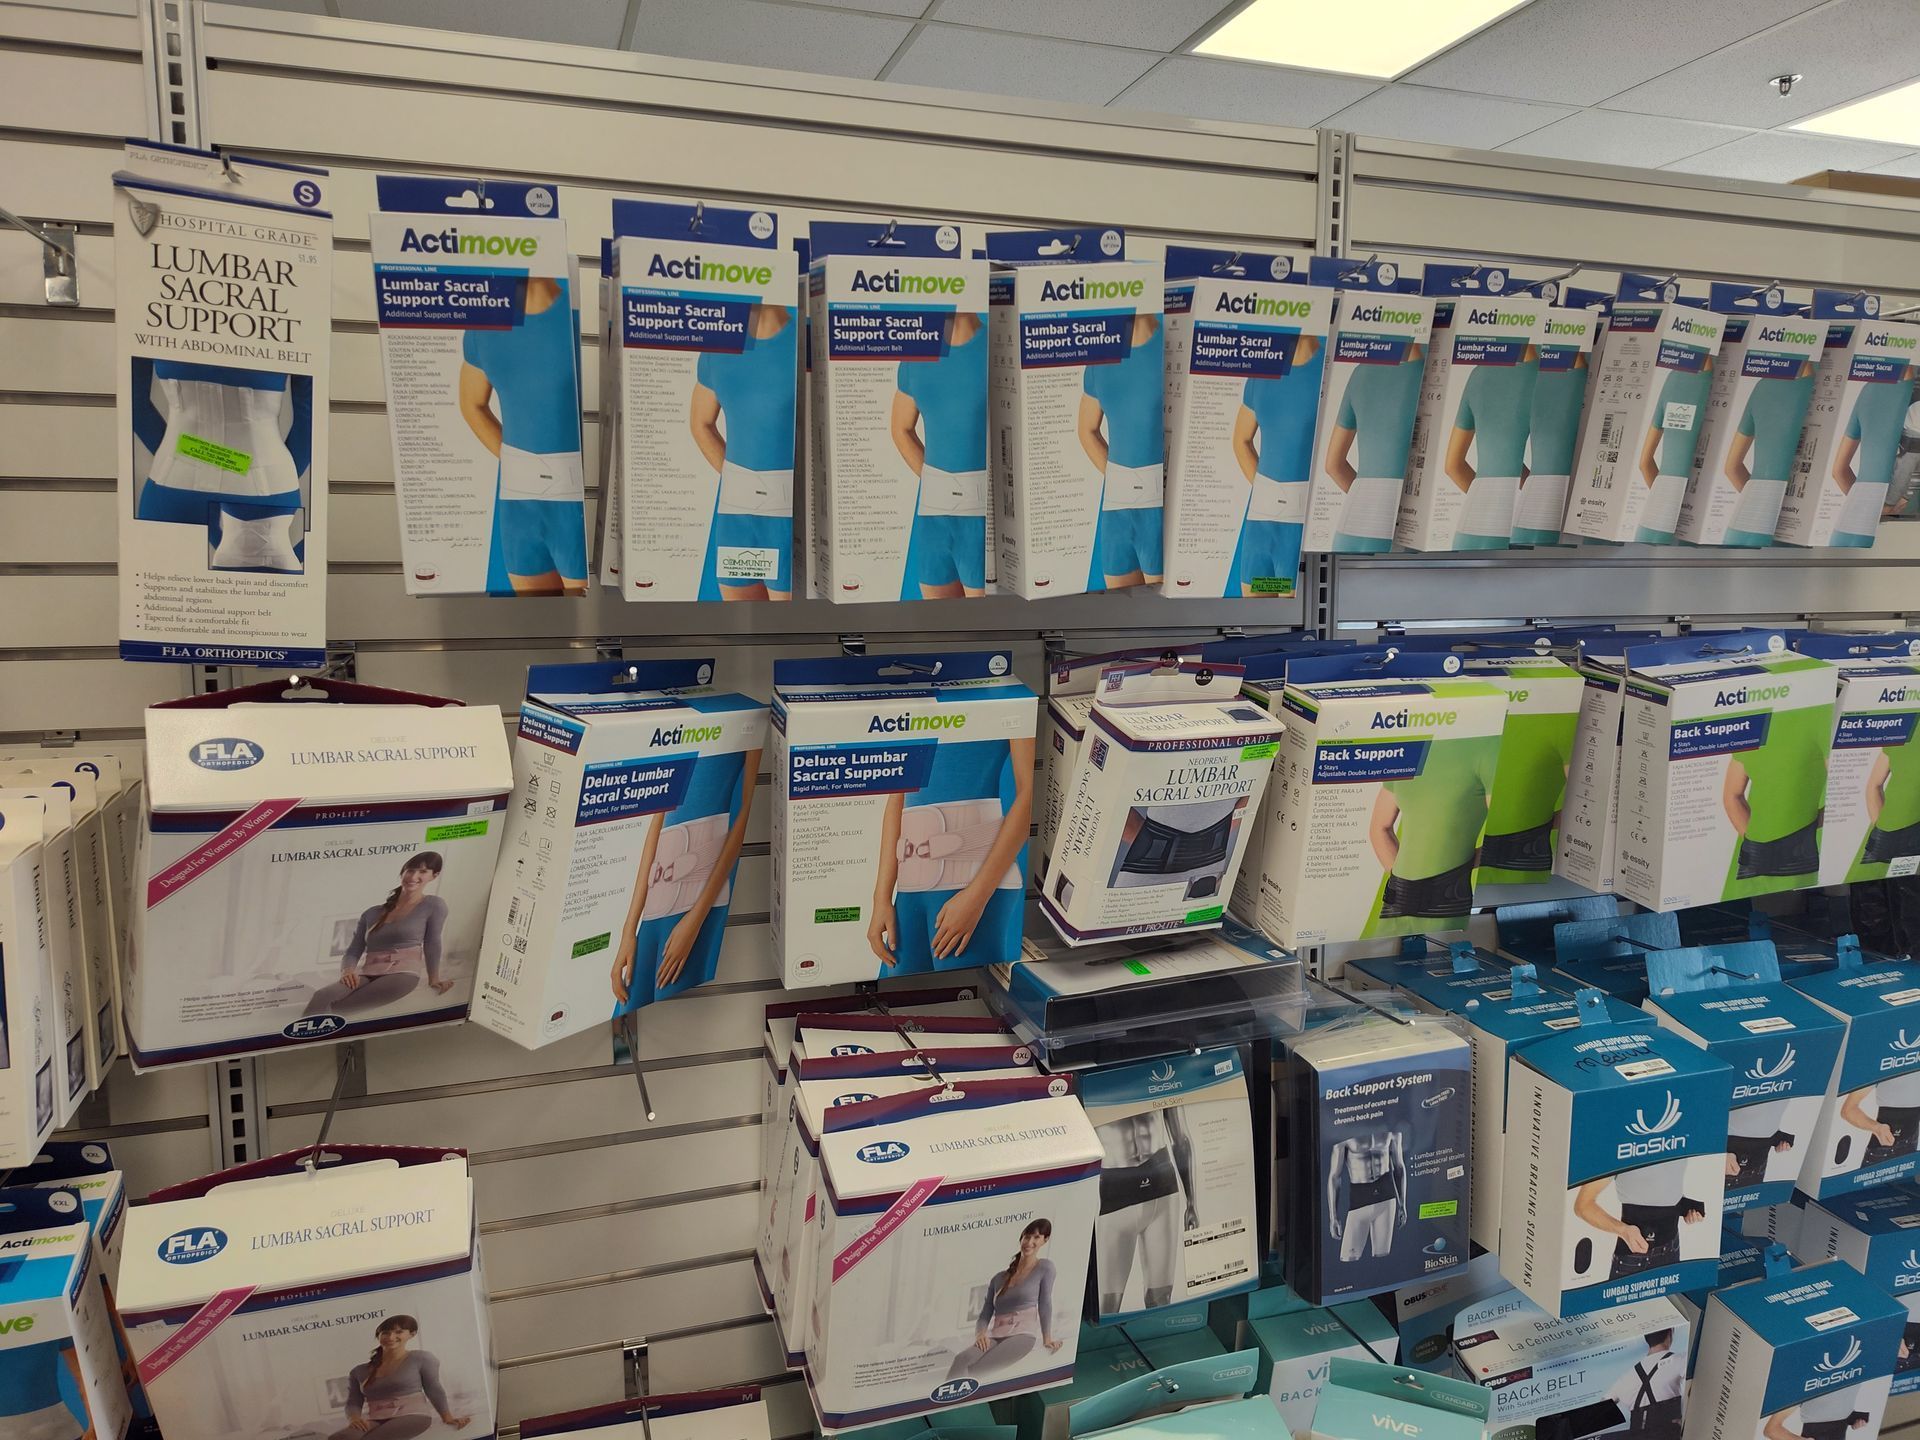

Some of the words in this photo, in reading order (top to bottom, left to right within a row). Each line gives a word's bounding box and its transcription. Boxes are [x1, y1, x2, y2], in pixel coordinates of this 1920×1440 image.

[299, 185, 315, 204] S
[161, 214, 246, 236] HOSPITAL
[255, 229, 312, 246] GRADE
[401, 228, 537, 256] Actimove
[151, 243, 297, 287] LUMBAR
[648, 254, 772, 285] Actimove
[382, 278, 439, 291] Lumbar
[445, 280, 489, 293] Sacral
[851, 269, 965, 294] Actimove
[1041, 278, 1144, 301] Actimove
[161, 274, 288, 313] SACRAL
[383, 293, 443, 306] Support
[449, 295, 510, 308] Comfort
[629, 301, 680, 314] Lumbar
[685, 304, 725, 318] Sacral
[1216, 292, 1311, 318] Actimove
[1352, 305, 1421, 324] Actimove
[146, 302, 301, 343] SUPPORT
[424, 311, 451, 319] Support
[628, 315, 683, 329] Support
[688, 319, 743, 332] Comfort
[1468, 309, 1535, 327] Actimove
[1025, 324, 1069, 336] Lumbar
[1072, 321, 1106, 333] Sacral
[1672, 317, 1717, 338] Actimove
[1759, 327, 1817, 344] Actimove
[135, 333, 176, 349] WITH
[182, 339, 273, 359] ABDOMINAL
[278, 350, 311, 363] BELT
[1025, 337, 1071, 349] Support
[1075, 333, 1121, 345] Comfort
[1341, 341, 1368, 349] Lumbar
[1369, 342, 1391, 350] Sacral
[1865, 332, 1916, 349] Actimove
[1340, 349, 1368, 357] Support
[723, 559, 772, 567] COMMUNITY
[144, 572, 166, 582] Helps
[168, 574, 191, 583] relieve
[193, 576, 213, 584] lower
[216, 576, 233, 585] back
[236, 579, 251, 587] pain
[253, 578, 267, 586] and
[270, 578, 308, 588] discomfort
[1715, 684, 1790, 707] Actimove
[868, 712, 966, 733] Actimove
[1371, 709, 1456, 730] Actimove
[650, 724, 722, 747] Actimove
[1674, 726, 1701, 740] Back
[1704, 721, 1750, 736] Support
[201, 742, 254, 759] FLA
[1148, 739, 1233, 750] PROFESSIONAL
[1236, 735, 1272, 744] GRADE
[291, 751, 356, 766] LUMBAR
[358, 748, 412, 762] SACRAL
[414, 746, 477, 760] SUPPORT
[793, 754, 847, 768] Deluxe
[852, 752, 908, 764] Lumbar
[1188, 756, 1228, 766] NEOPRENE
[1319, 750, 1350, 761] Back
[1354, 748, 1404, 760] Support
[793, 768, 839, 782] Sacral
[844, 766, 903, 780] Support
[1167, 764, 1239, 785] LUMBAR
[1324, 764, 1339, 772] Stays
[1383, 767, 1416, 775] Compression
[585, 774, 628, 789] Deluxe
[631, 767, 675, 783] Lumbar
[582, 788, 620, 806] Sacral
[623, 782, 669, 800] Support
[811, 784, 830, 792] Panel,
[1134, 787, 1193, 801] SACRAL
[1194, 779, 1256, 798] SUPPORT
[807, 802, 852, 810] SACROLUMBAR
[160, 862, 195, 888] Designed
[190, 851, 208, 870] For
[203, 831, 236, 857] Women,
[233, 826, 248, 838] By
[243, 807, 274, 831] Women
[271, 850, 322, 863] LUMBAR
[322, 847, 366, 860] SACRAL
[368, 843, 419, 856] SUPPORT
[1630, 854, 1649, 869] essity
[1148, 1081, 1182, 1093] BioSkin
[1326, 1088, 1350, 1100] Back
[1352, 1080, 1394, 1096] Support
[1396, 1072, 1432, 1088] System
[1732, 1080, 1792, 1098] BioSkin
[1334, 1103, 1363, 1115] Treatment
[1334, 1116, 1354, 1125] chronic
[1356, 1113, 1369, 1121] back
[1370, 1111, 1383, 1120] pain
[1530, 1085, 1542, 1160] INNOVATIVE
[929, 1138, 976, 1152] LUMBAR
[977, 1132, 1019, 1146] SACRAL
[1019, 1125, 1067, 1140] SUPPORT
[1618, 1135, 1686, 1159] BioSkin
[1413, 1167, 1439, 1177] Lumbago
[1854, 1170, 1875, 1183] LUMBAR
[1876, 1165, 1899, 1178] SUPPORT
[1899, 1161, 1915, 1174] BRACE
[1527, 1163, 1539, 1215] BRACING
[251, 1229, 312, 1250] LUMBAR
[314, 1221, 367, 1240] SACRAL
[371, 1210, 434, 1231] SUPPORT
[1, 1234, 74, 1249] Actimove
[167, 1231, 219, 1252] FLA
[1424, 1255, 1458, 1269] BioSkin
[1523, 1218, 1536, 1288] SOLUTIONS
[1603, 1283, 1627, 1298] LUMBAR
[1629, 1278, 1659, 1293] SUPPORT
[1660, 1274, 1680, 1288] BRACE
[1303, 1320, 1341, 1335] vive
[1509, 1343, 1523, 1351] La
[1525, 1328, 1573, 1350] Ceinture
[1575, 1321, 1599, 1335] pour
[1602, 1317, 1612, 1326] le
[1614, 1311, 1636, 1325] dos
[1497, 1383, 1540, 1406] BACK
[1547, 1371, 1586, 1392] BELT
[1804, 1367, 1862, 1392] BioSkin
[1434, 1393, 1478, 1410] STANDARD
[1497, 1403, 1512, 1413] With
[1514, 1391, 1561, 1409] Suspenders
[1372, 1414, 1419, 1434] vive
